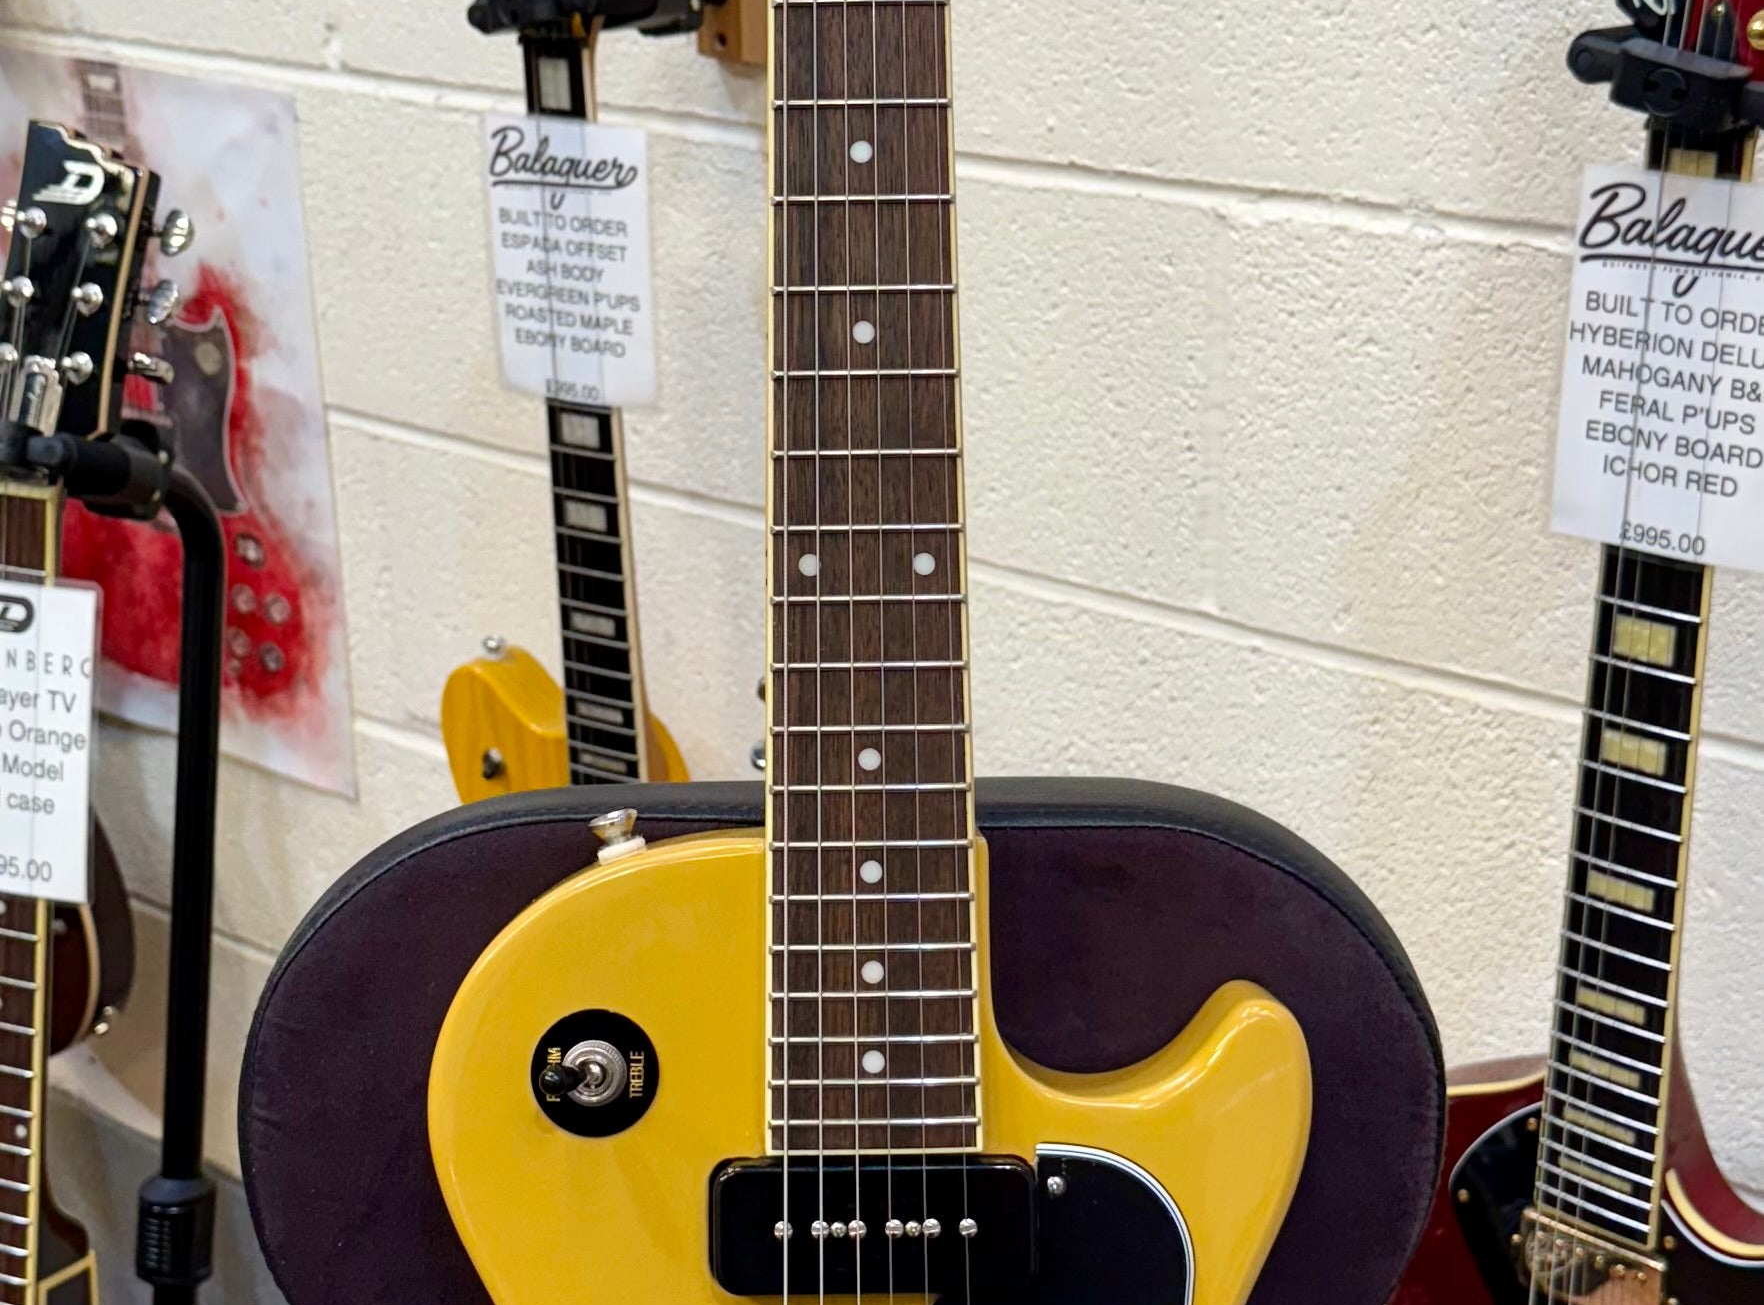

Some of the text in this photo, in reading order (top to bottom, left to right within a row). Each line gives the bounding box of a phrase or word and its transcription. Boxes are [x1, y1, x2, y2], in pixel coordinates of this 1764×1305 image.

[489, 126, 638, 210] Balaguer
[499, 207, 628, 237] BUILT TO ORDER
[565, 239, 628, 262] OFFSET
[526, 259, 604, 282] ASH BODY
[496, 278, 590, 305] EVERGREEN
[1585, 290, 1655, 318] BUILT
[1661, 301, 1693, 325] TO
[505, 303, 633, 335] ROASTED MAPLE
[515, 327, 626, 358] EBONY BOARD
[1569, 320, 1693, 359] HYBERION
[1581, 355, 1723, 397] MAHOGANY
[1599, 389, 1756, 436] FERAL P'UPS
[1585, 419, 1764, 469] EBONY BOARD
[1602, 454, 1738, 497] ICHOR RED
[1619, 520, 1706, 556] £995.00
[48, 690, 77, 713] TV
[9, 719, 87, 754] Orange
[2, 753, 65, 782] Model
[6, 792, 56, 815] case
[546, 1047, 562, 1102] RHM
[629, 1050, 645, 1099] TREBLE
